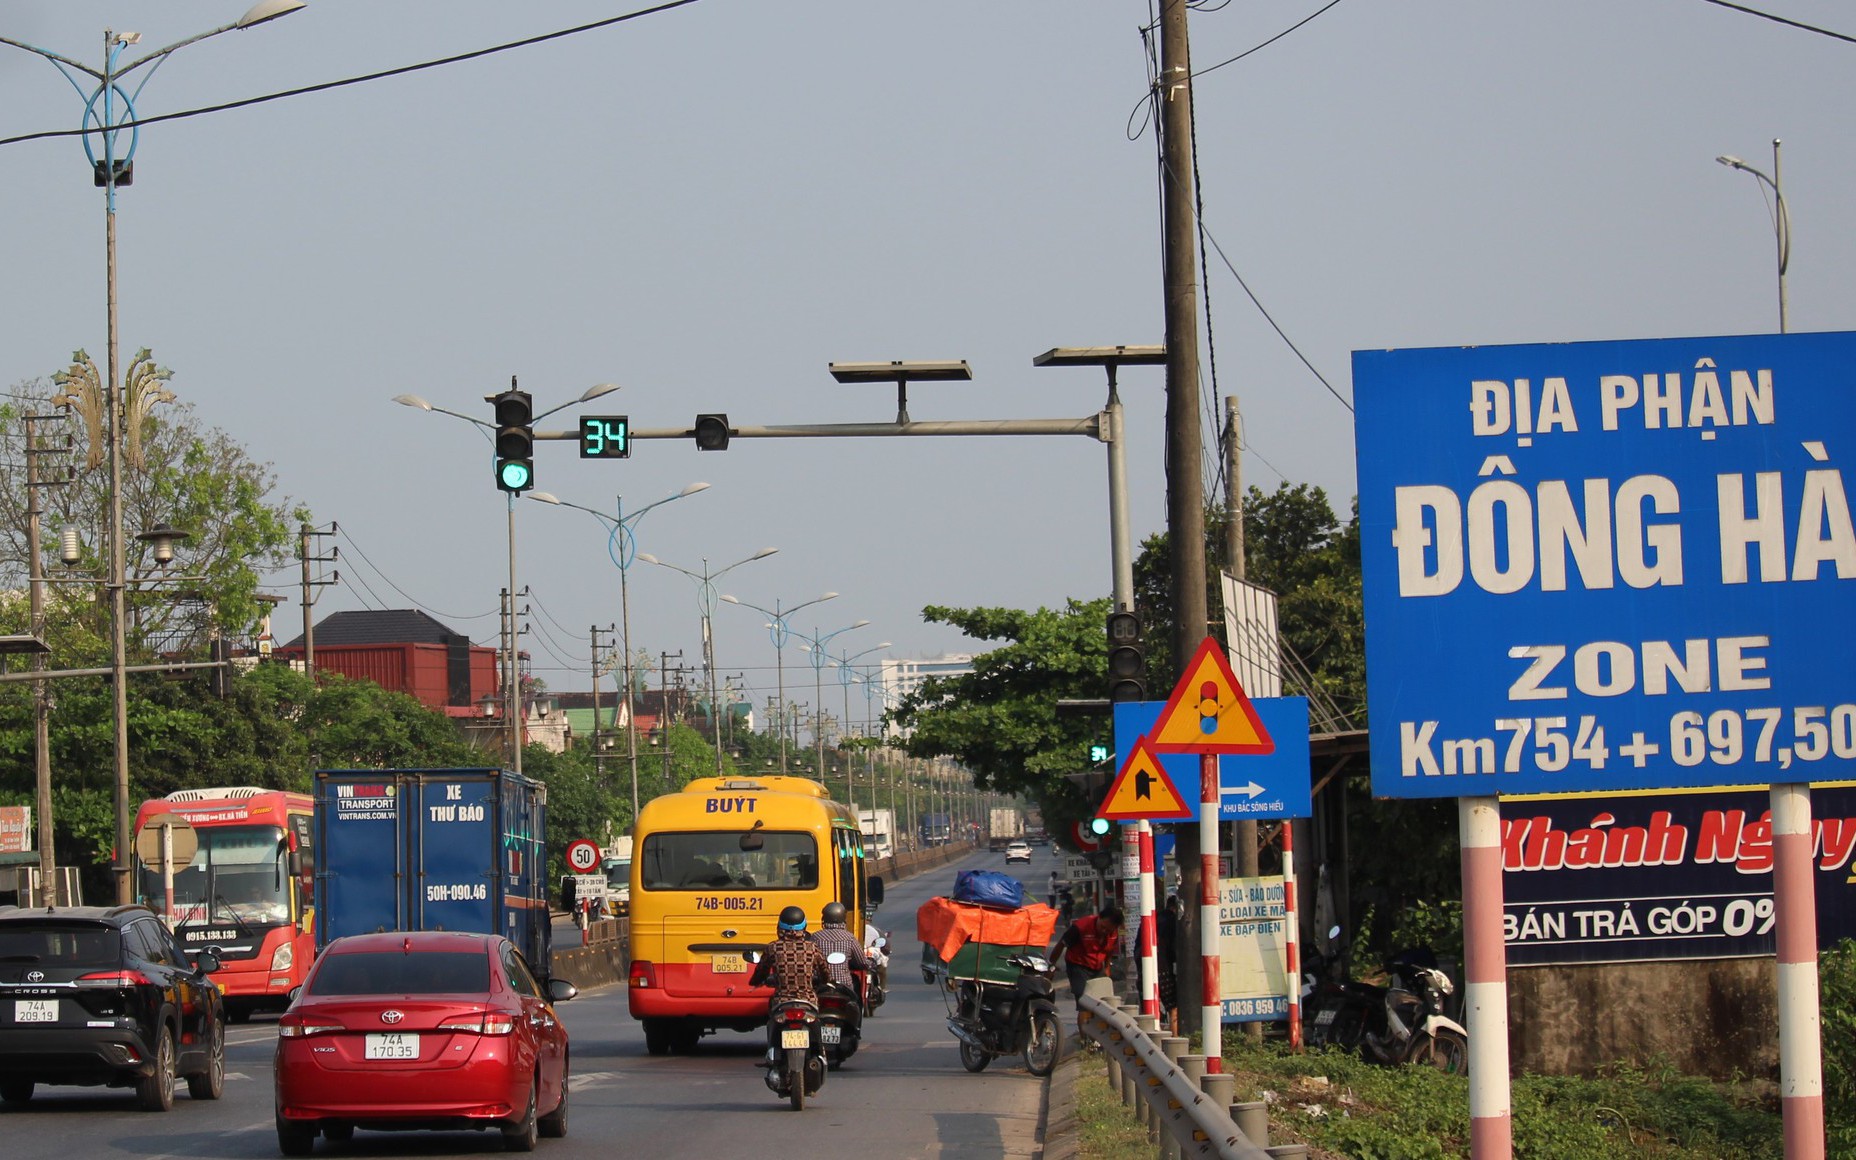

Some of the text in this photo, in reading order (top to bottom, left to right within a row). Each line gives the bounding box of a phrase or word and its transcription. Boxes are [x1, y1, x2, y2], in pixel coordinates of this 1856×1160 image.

[1470, 357, 1775, 447] ĐỊA PHẬN
[586, 420, 625, 454] 34
[1392, 441, 1856, 597] ĐÔNG HÀ
[1508, 635, 1771, 701] ZONE
[1091, 746, 1107, 761] 34
[446, 785, 462, 800] XE
[340, 799, 394, 809] TRANSPORT
[705, 795, 757, 813] BUÝT
[1223, 804, 1237, 813] KHU
[430, 803, 484, 822] THƯ BÁO
[1501, 812, 1688, 872] Khánh
[576, 849, 590, 864] 50
[427, 884, 486, 901] 50H-090.46
[1250, 883, 1264, 902] BẢO
[696, 897, 763, 911] 74B-005.21
[1230, 907, 1251, 921] LOẠI
[1254, 906, 1267, 917] XE
[1503, 907, 1566, 941] BÁN
[1572, 902, 1640, 938] TRẢ
[1647, 901, 1717, 934] GÓP
[1220, 922, 1281, 938] XE ĐẠP ĐIỆN
[722, 956, 737, 964] 74B
[28, 1001, 45, 1011] 74A
[1229, 1001, 1253, 1016] 0836
[1256, 1000, 1274, 1015] 959
[20, 1011, 53, 1021] 209.19
[381, 1034, 403, 1045] 74A
[373, 1046, 413, 1057] 170.35
